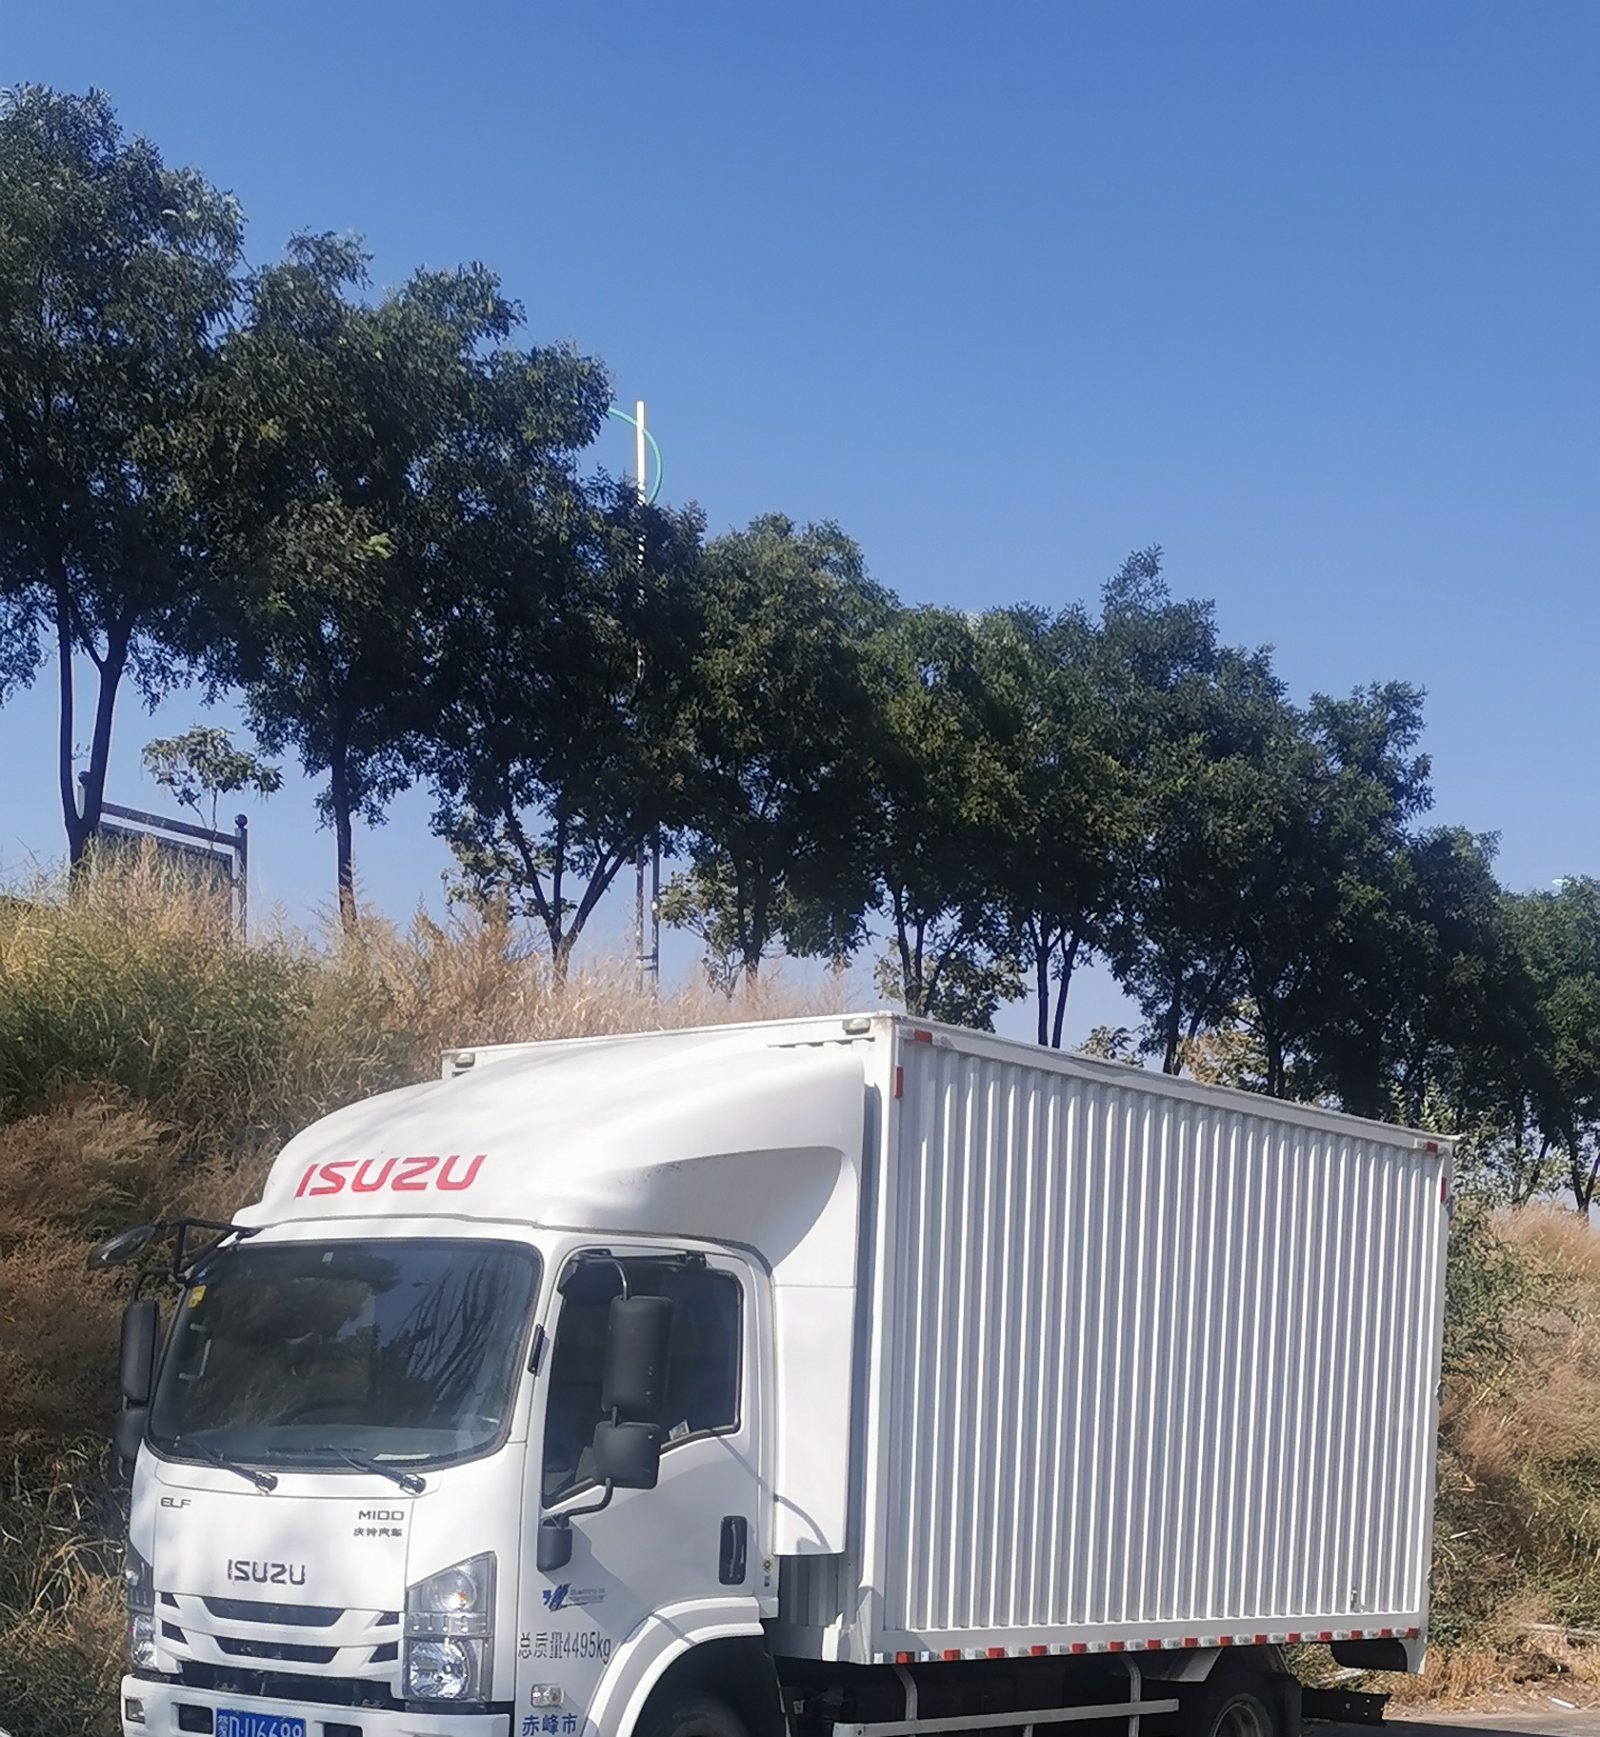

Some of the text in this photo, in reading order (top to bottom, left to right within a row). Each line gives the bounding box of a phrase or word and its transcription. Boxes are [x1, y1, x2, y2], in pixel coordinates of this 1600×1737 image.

[294, 1154, 488, 1199] ISUZU
[160, 1496, 192, 1509] ELF
[226, 1558, 306, 1586] ISUZU
[522, 1713, 578, 1737] 赤峰市
